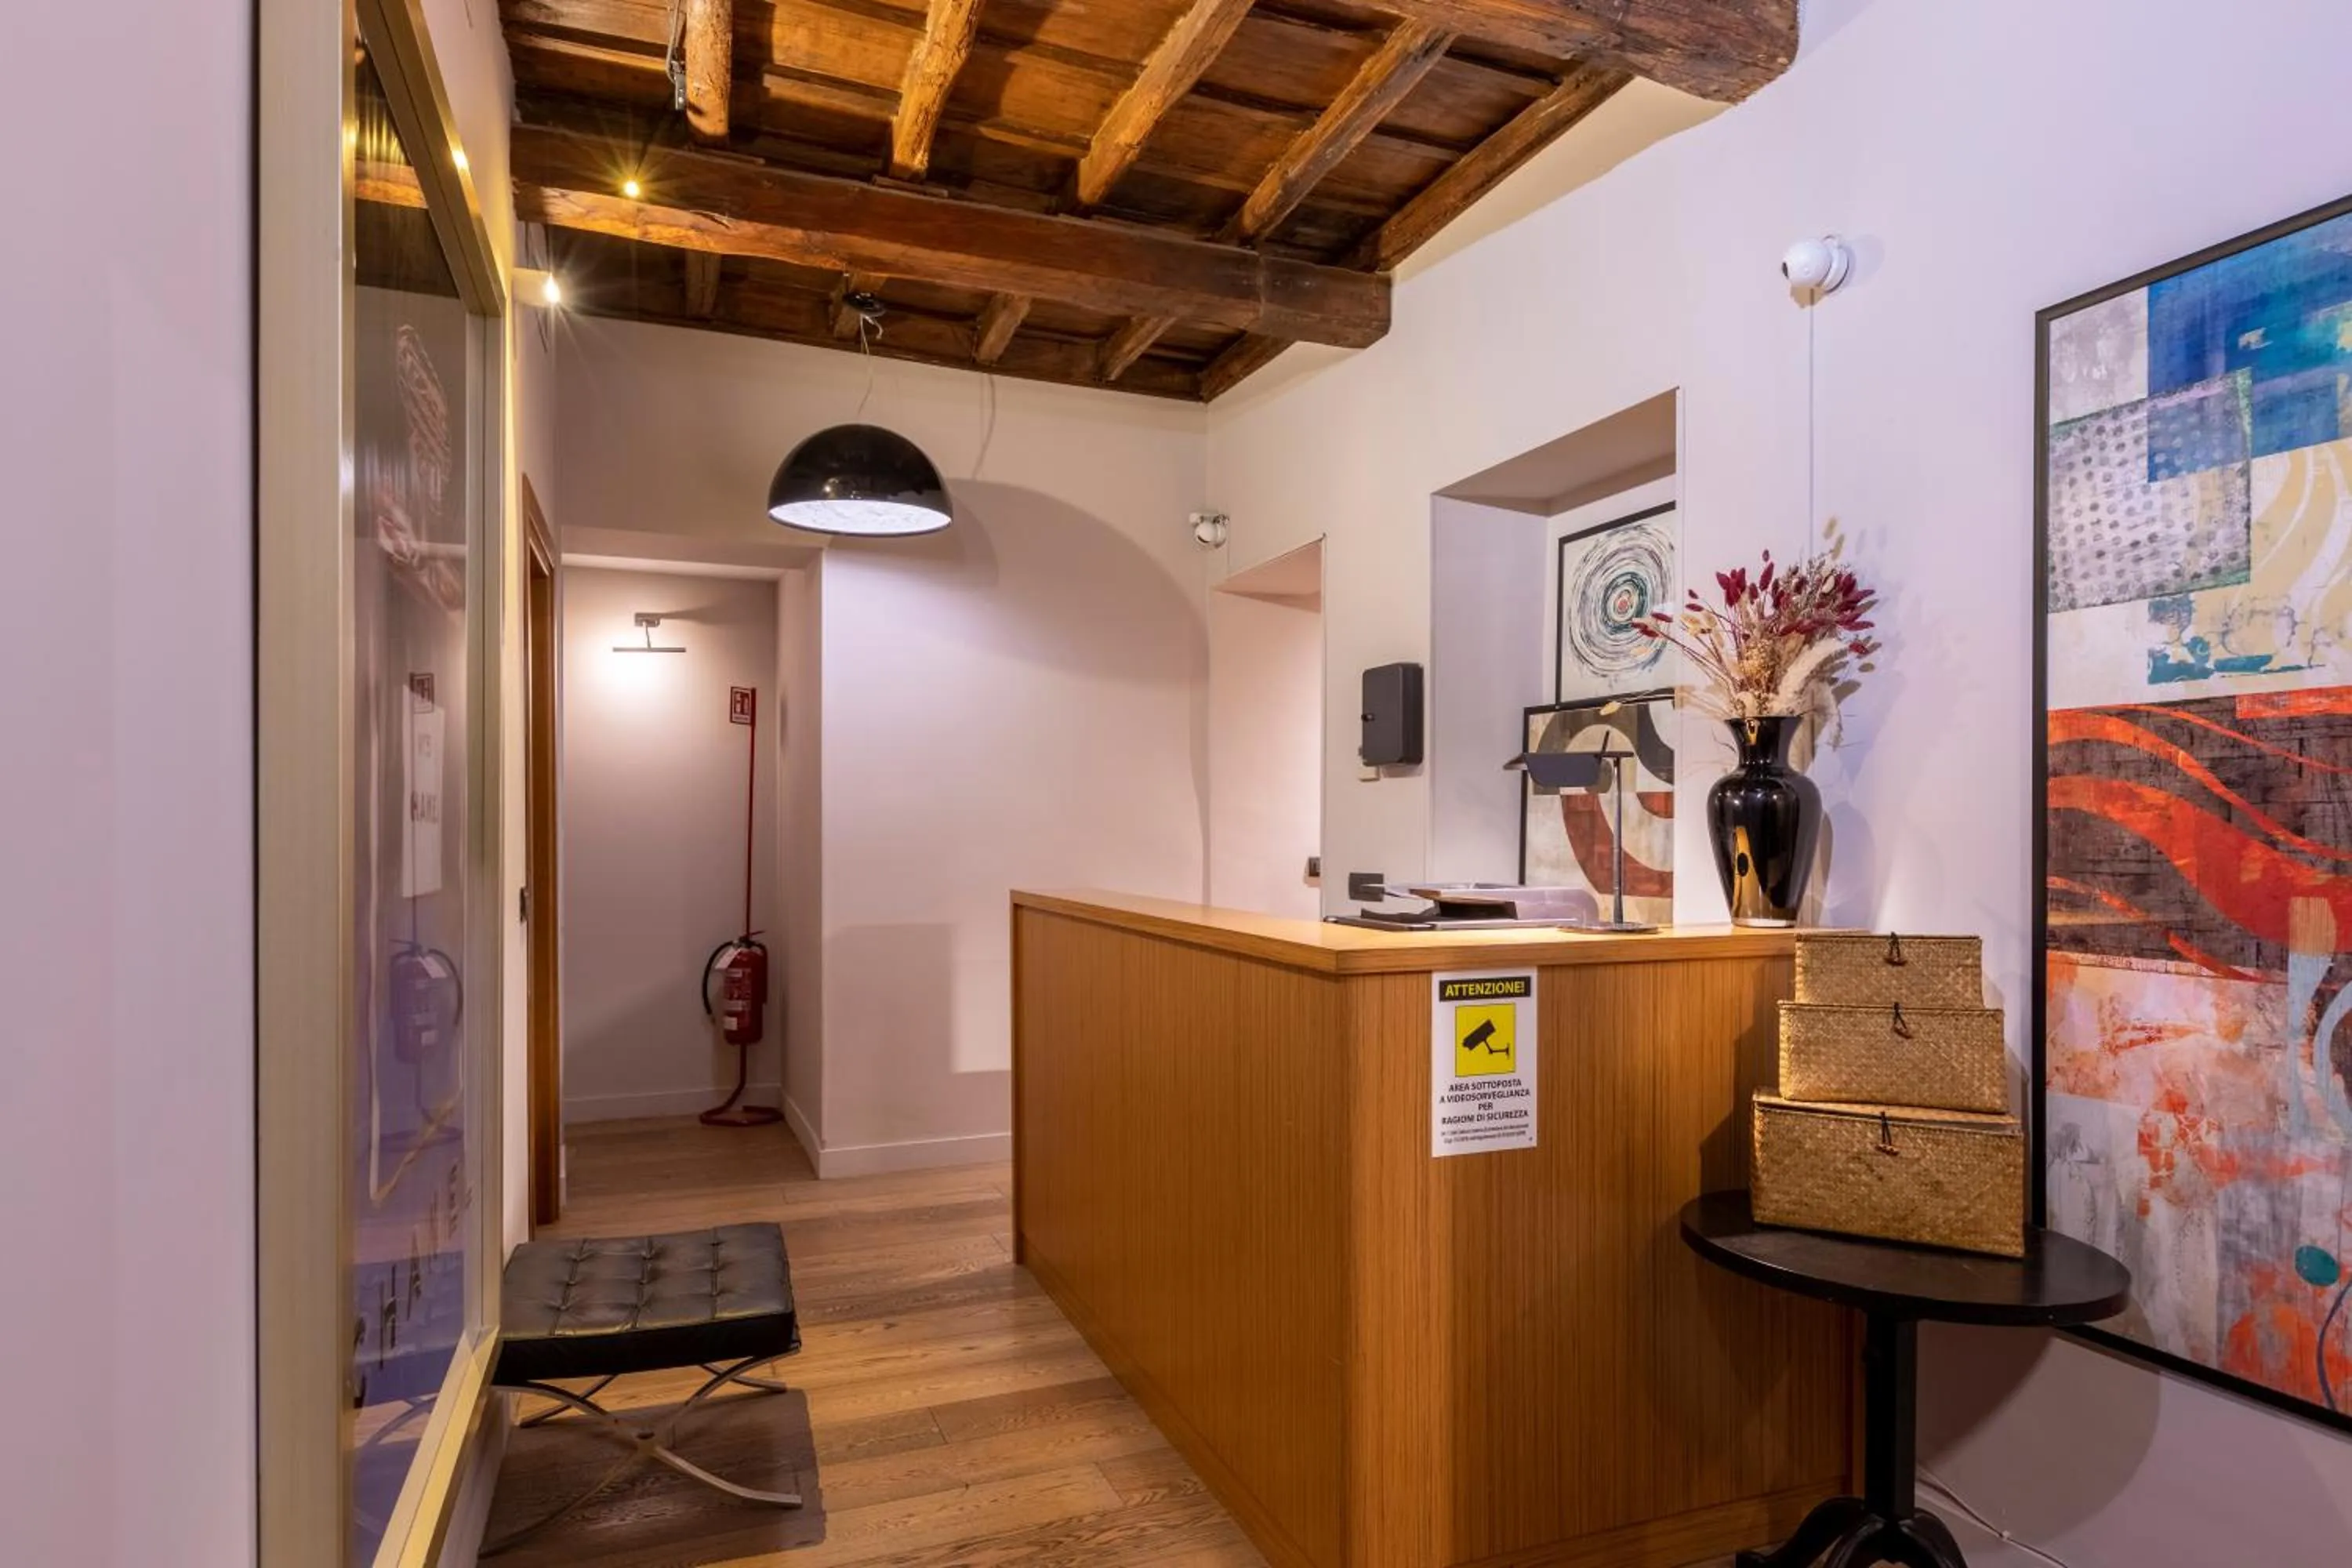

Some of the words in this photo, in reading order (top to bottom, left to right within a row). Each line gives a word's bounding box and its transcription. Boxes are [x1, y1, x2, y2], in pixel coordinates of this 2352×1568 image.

[1445, 981, 1525, 997] ATTENZIONE!
[1449, 1083, 1470, 1092] AREA
[1471, 1078, 1522, 1090] SOTTOPOSTA
[1439, 1095, 1445, 1104] A
[1446, 1088, 1530, 1103] VIDEOSORVEGLIANZA
[1478, 1102, 1494, 1111] PER
[1442, 1114, 1474, 1125] RAGIONI
[1476, 1113, 1486, 1122] DI
[1486, 1109, 1529, 1121] SICUREZZA
